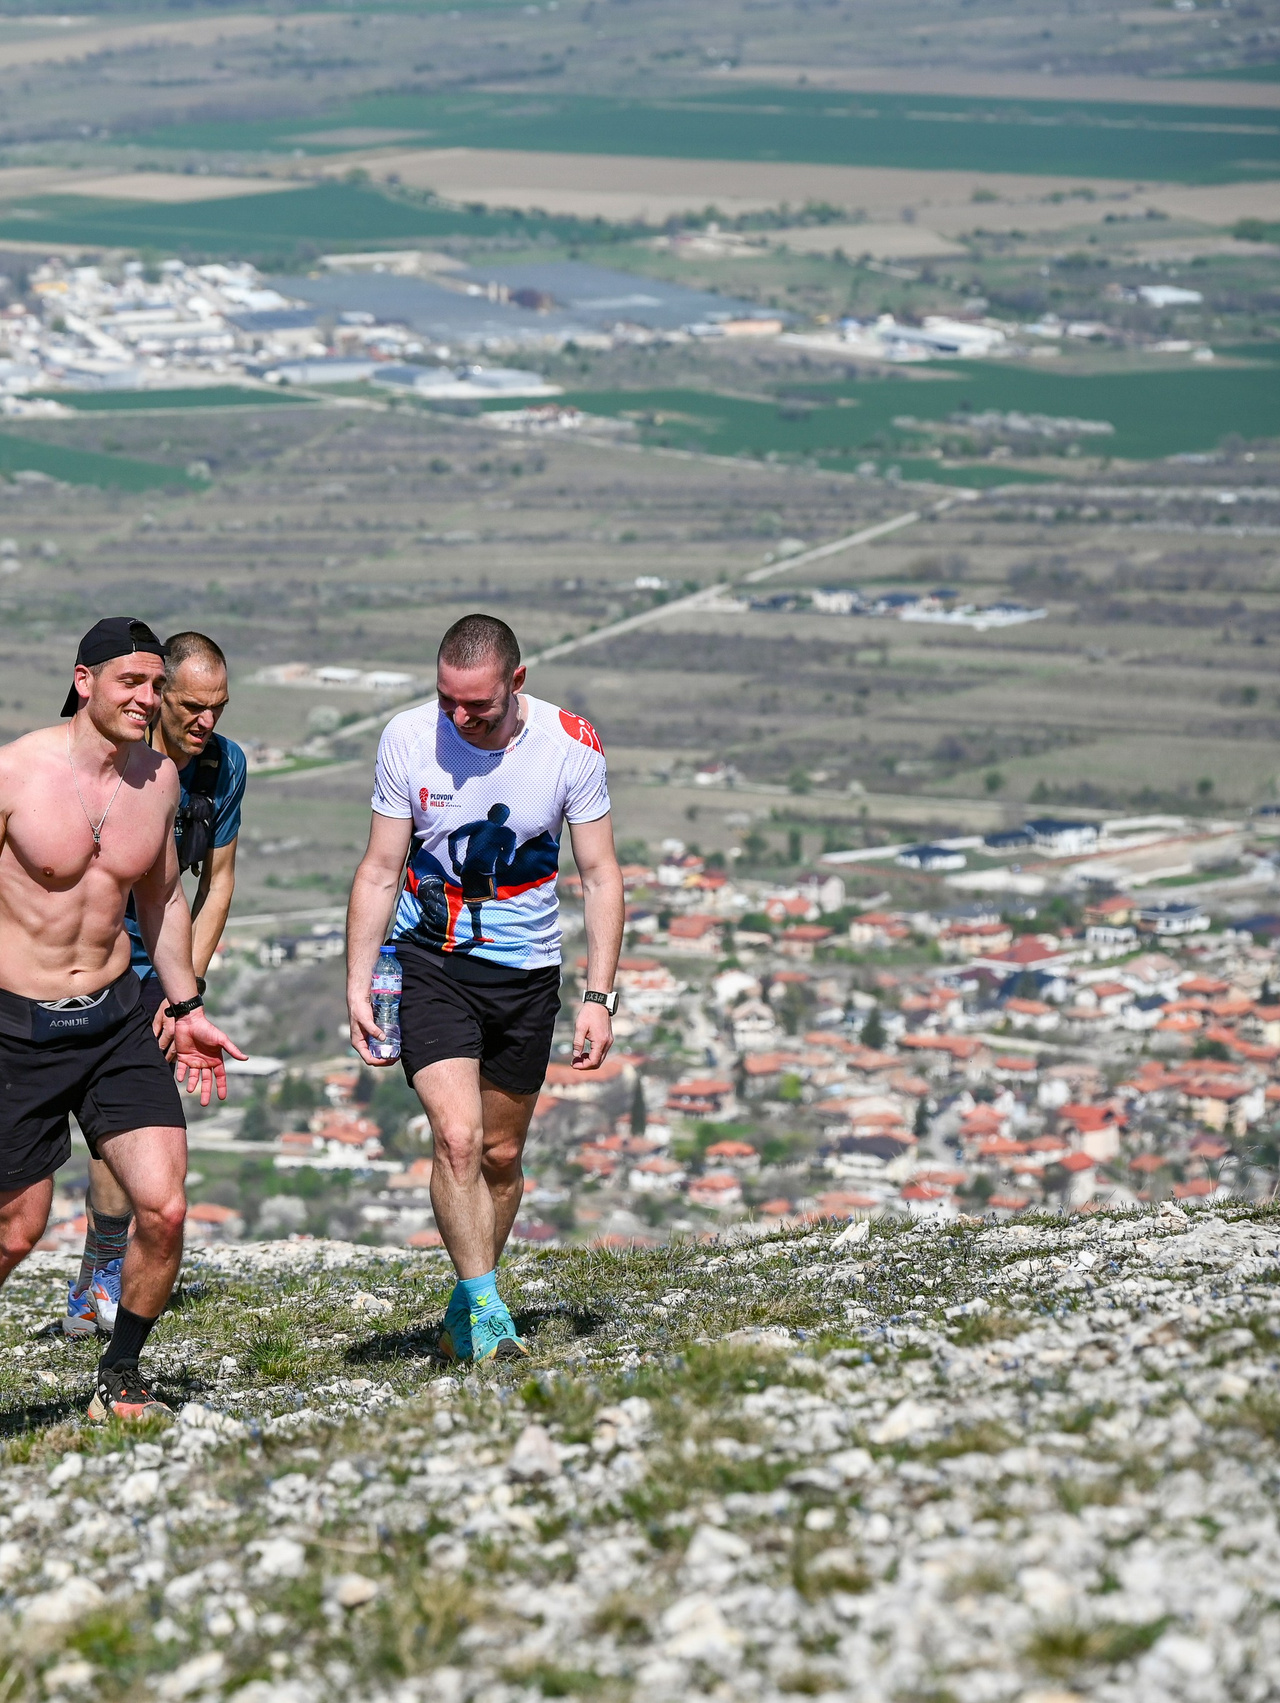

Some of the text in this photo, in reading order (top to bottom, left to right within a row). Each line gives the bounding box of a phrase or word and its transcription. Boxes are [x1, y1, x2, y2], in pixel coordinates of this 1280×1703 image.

[430, 793, 454, 801] PLOVDIV
[429, 800, 445, 808] HILLS
[49, 1016, 89, 1028] AONIJIE
